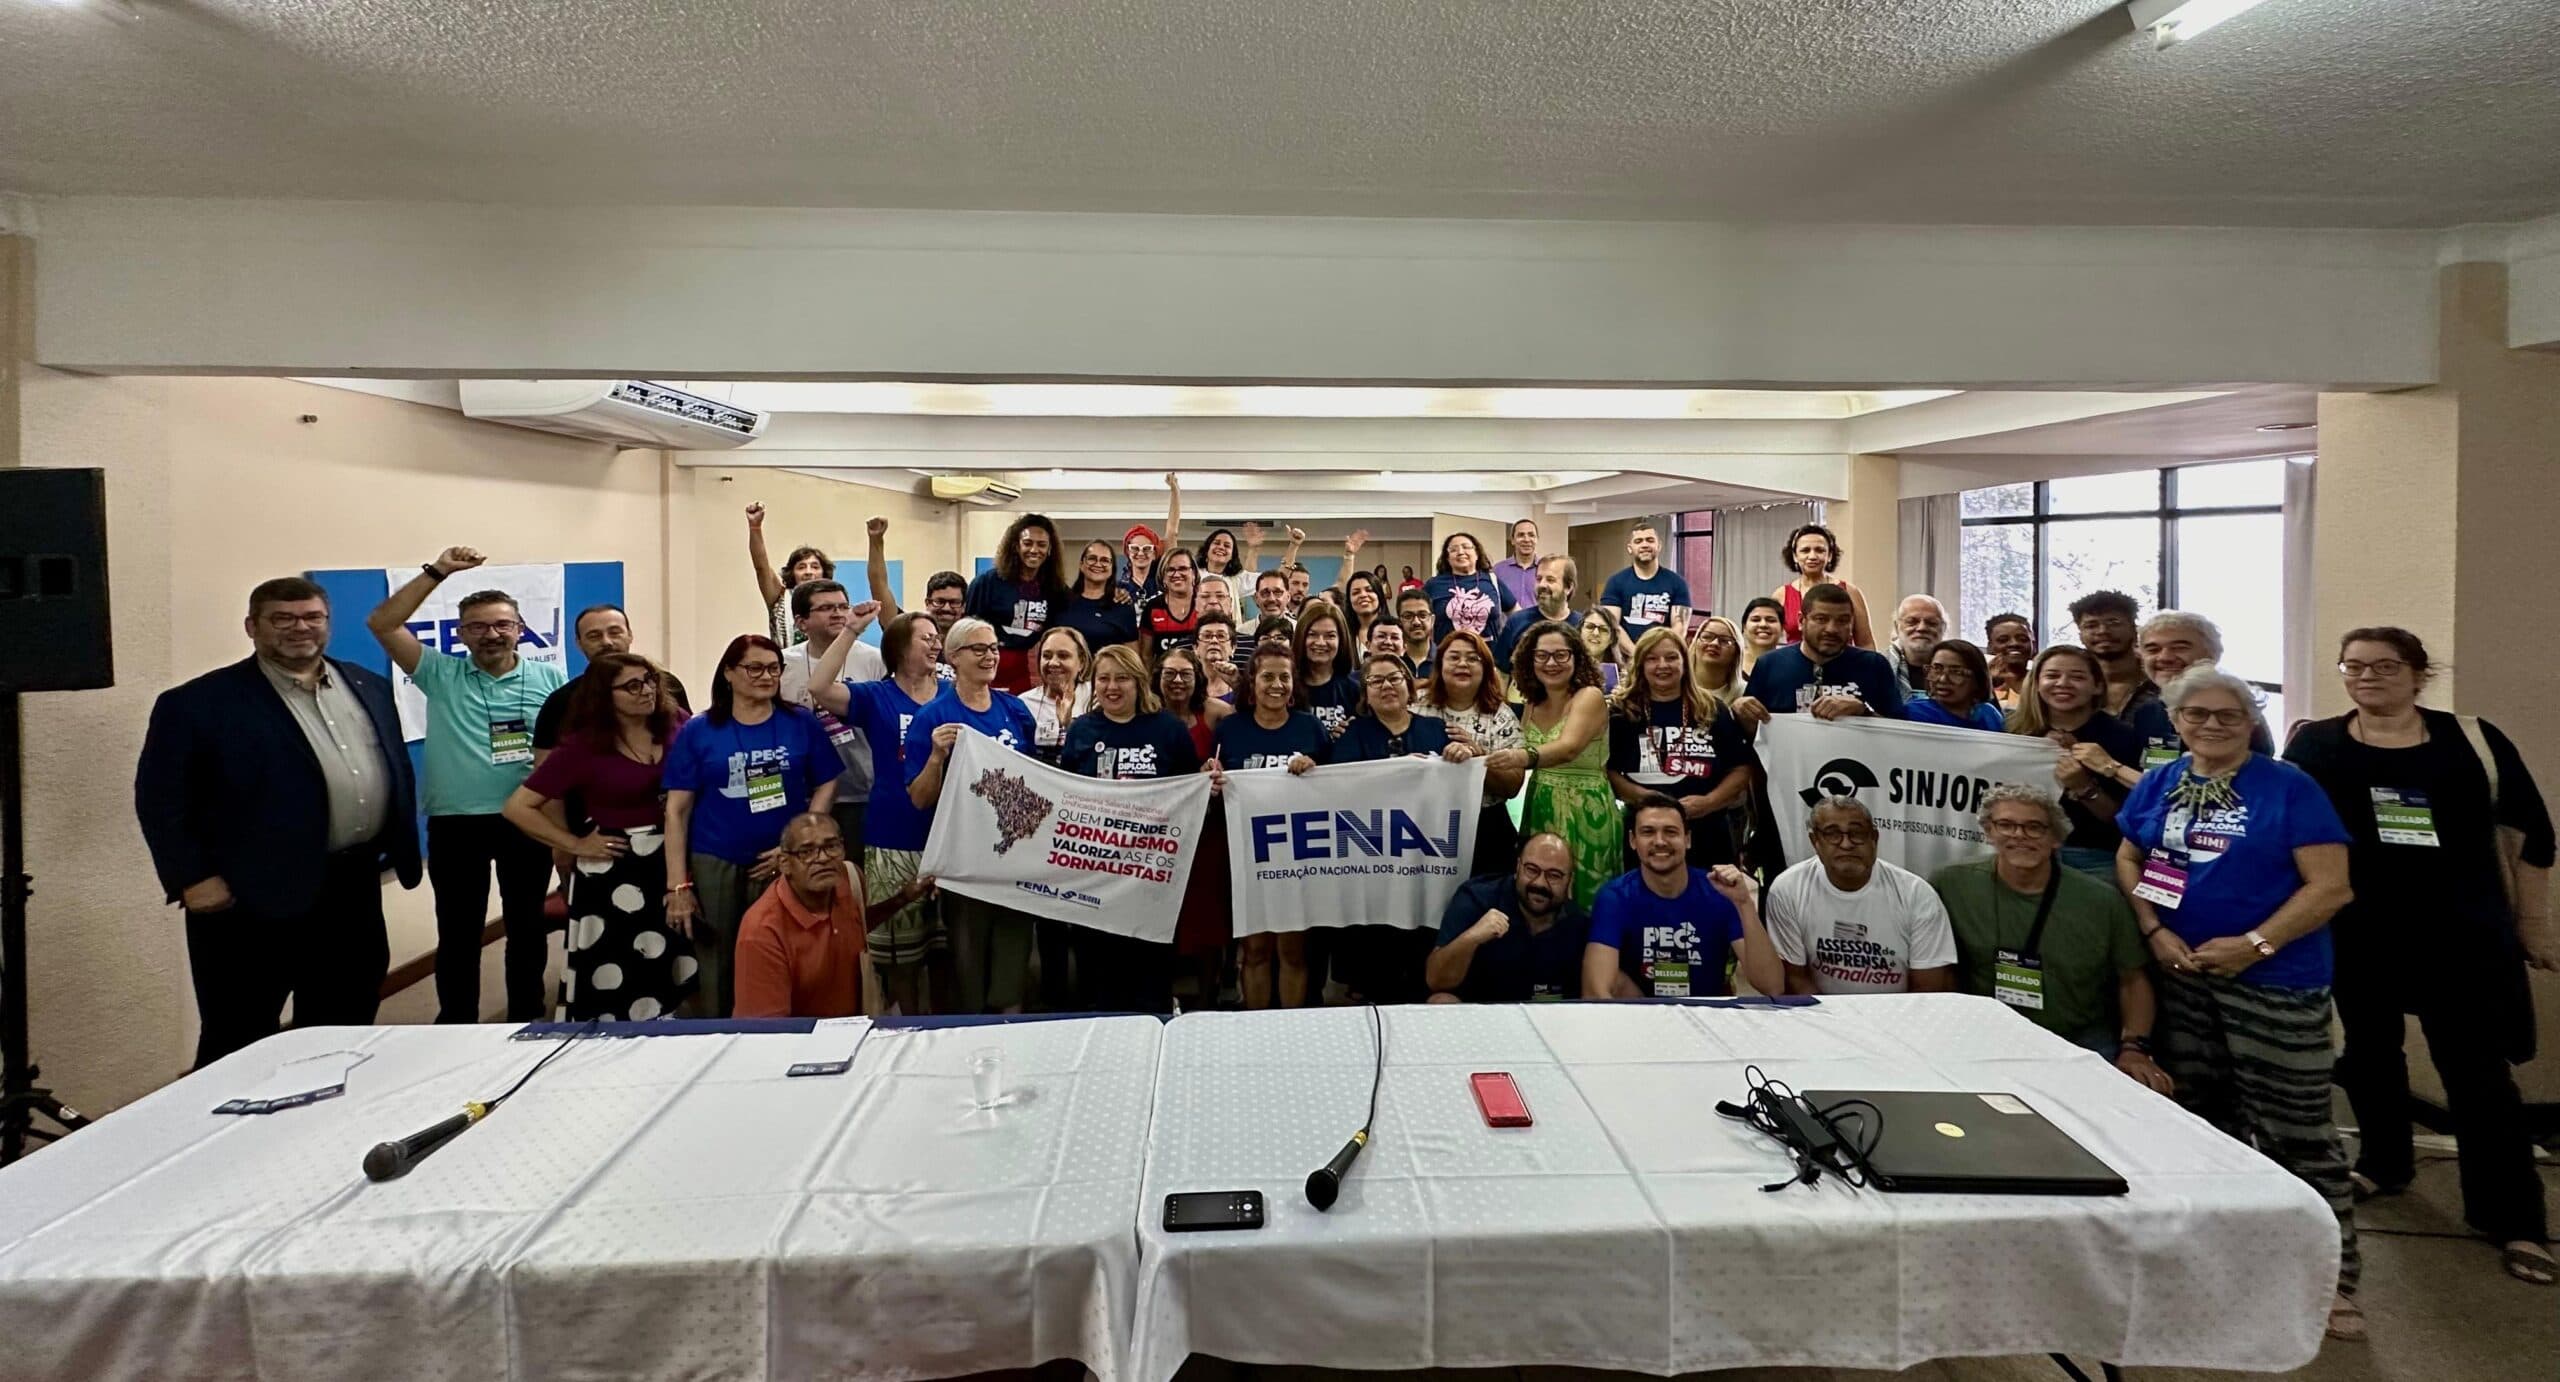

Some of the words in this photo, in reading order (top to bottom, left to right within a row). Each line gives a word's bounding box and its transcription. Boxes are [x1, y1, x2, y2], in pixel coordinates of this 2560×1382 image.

[1119, 747, 1152, 763] PEC
[1118, 762, 1157, 771] DIPLOMA
[749, 782, 782, 795] DELEGADO
[1058, 808, 1100, 826] QUEM
[1104, 818, 1168, 835] DEFENDE
[1170, 826, 1181, 837] O
[1893, 819, 1944, 836] PROFISSIONAIS
[1946, 827, 1956, 838] NO
[2376, 814, 2430, 824] DELEGADO
[1054, 822, 1179, 855] JORNALISMO
[1251, 809, 1461, 863] FENAJ
[2195, 835, 2224, 848] SIM!
[1053, 837, 1121, 860] VALORIZA
[1124, 851, 1141, 863] AS
[1145, 853, 1153, 864] E
[1156, 856, 1175, 868] OS
[1047, 851, 1173, 883] JORNALISTAS!
[1257, 865, 1317, 881] FEDERAÇÃO
[1320, 864, 1371, 876] NACIONAL
[1373, 865, 1394, 874] DOS
[1397, 864, 1458, 876] JORNALISTAS
[1644, 925, 1693, 949] PEC
[1817, 937, 1882, 956] ASSESSOR
[1882, 947, 1896, 956] de
[1816, 951, 1889, 970] IMPRENSA
[1812, 960, 1902, 984] Jornalista
[1996, 972, 2040, 986] DELEGADO
